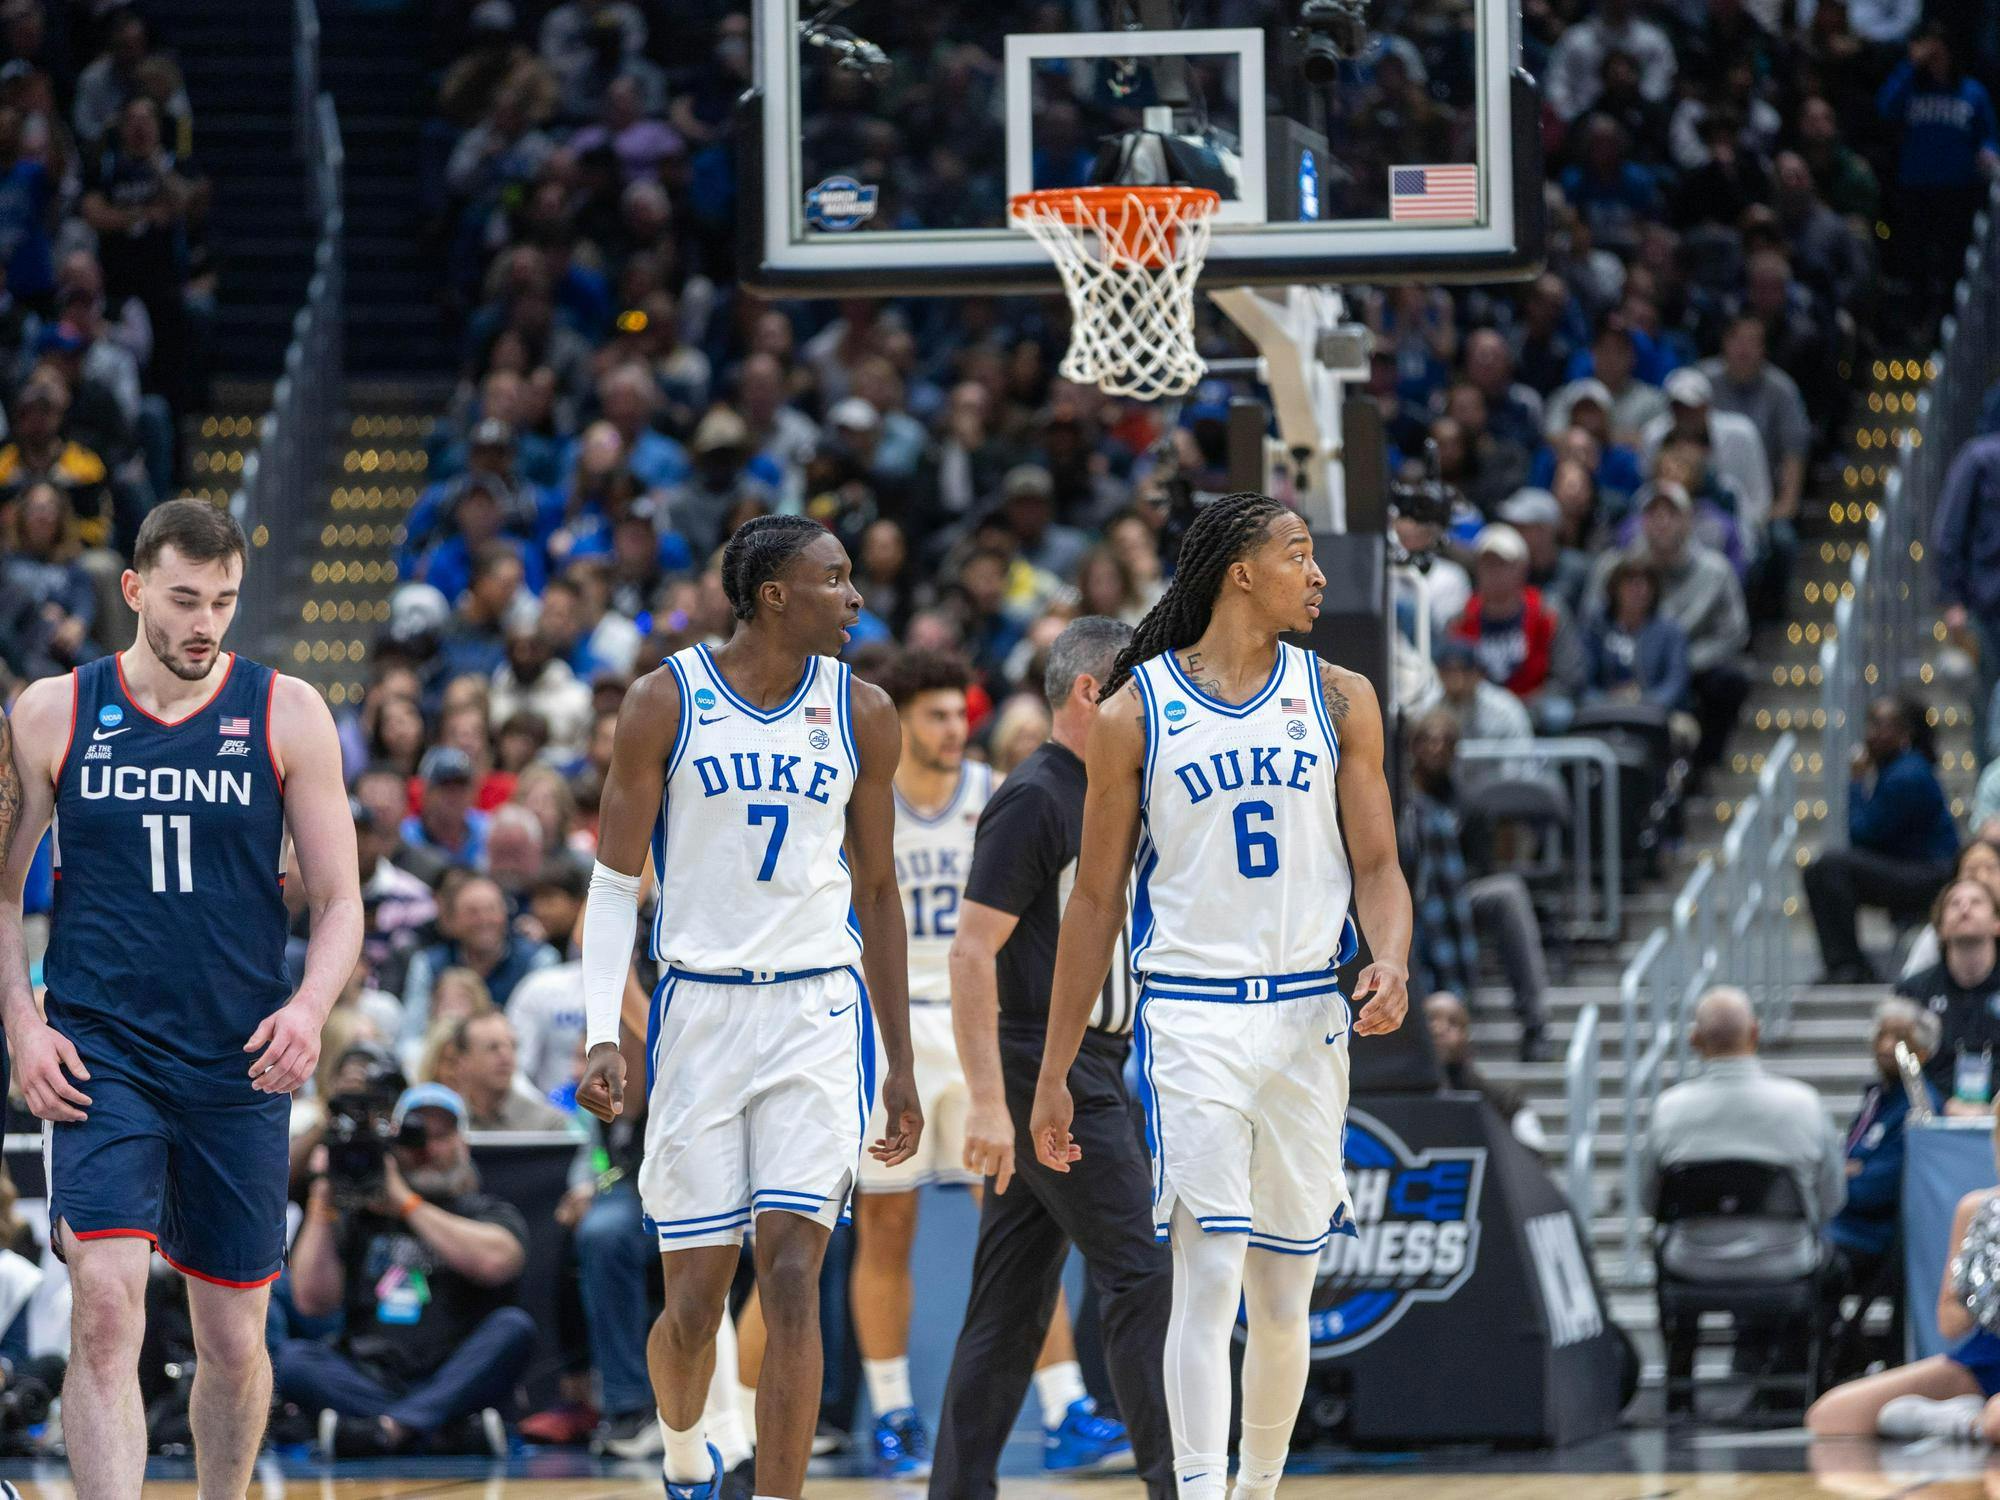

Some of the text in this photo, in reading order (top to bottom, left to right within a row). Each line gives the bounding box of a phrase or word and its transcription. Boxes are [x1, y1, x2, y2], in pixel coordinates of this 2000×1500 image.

[696, 696, 715, 705] NCAA
[1167, 708, 1186, 717] NCAA
[98, 744, 112, 752] THE
[219, 746, 251, 754] EAST
[223, 739, 246, 747] BIG
[81, 765, 251, 806] UCONN
[692, 752, 838, 804] DUKE
[1174, 747, 1318, 804] DUKE
[142, 814, 193, 893] 11
[747, 804, 789, 882] 7
[1232, 800, 1279, 879] 6
[895, 849, 959, 884] UK
[911, 885, 958, 936] 12
[1244, 979, 1269, 1001] D
[1318, 1221, 1468, 1277] NESS
